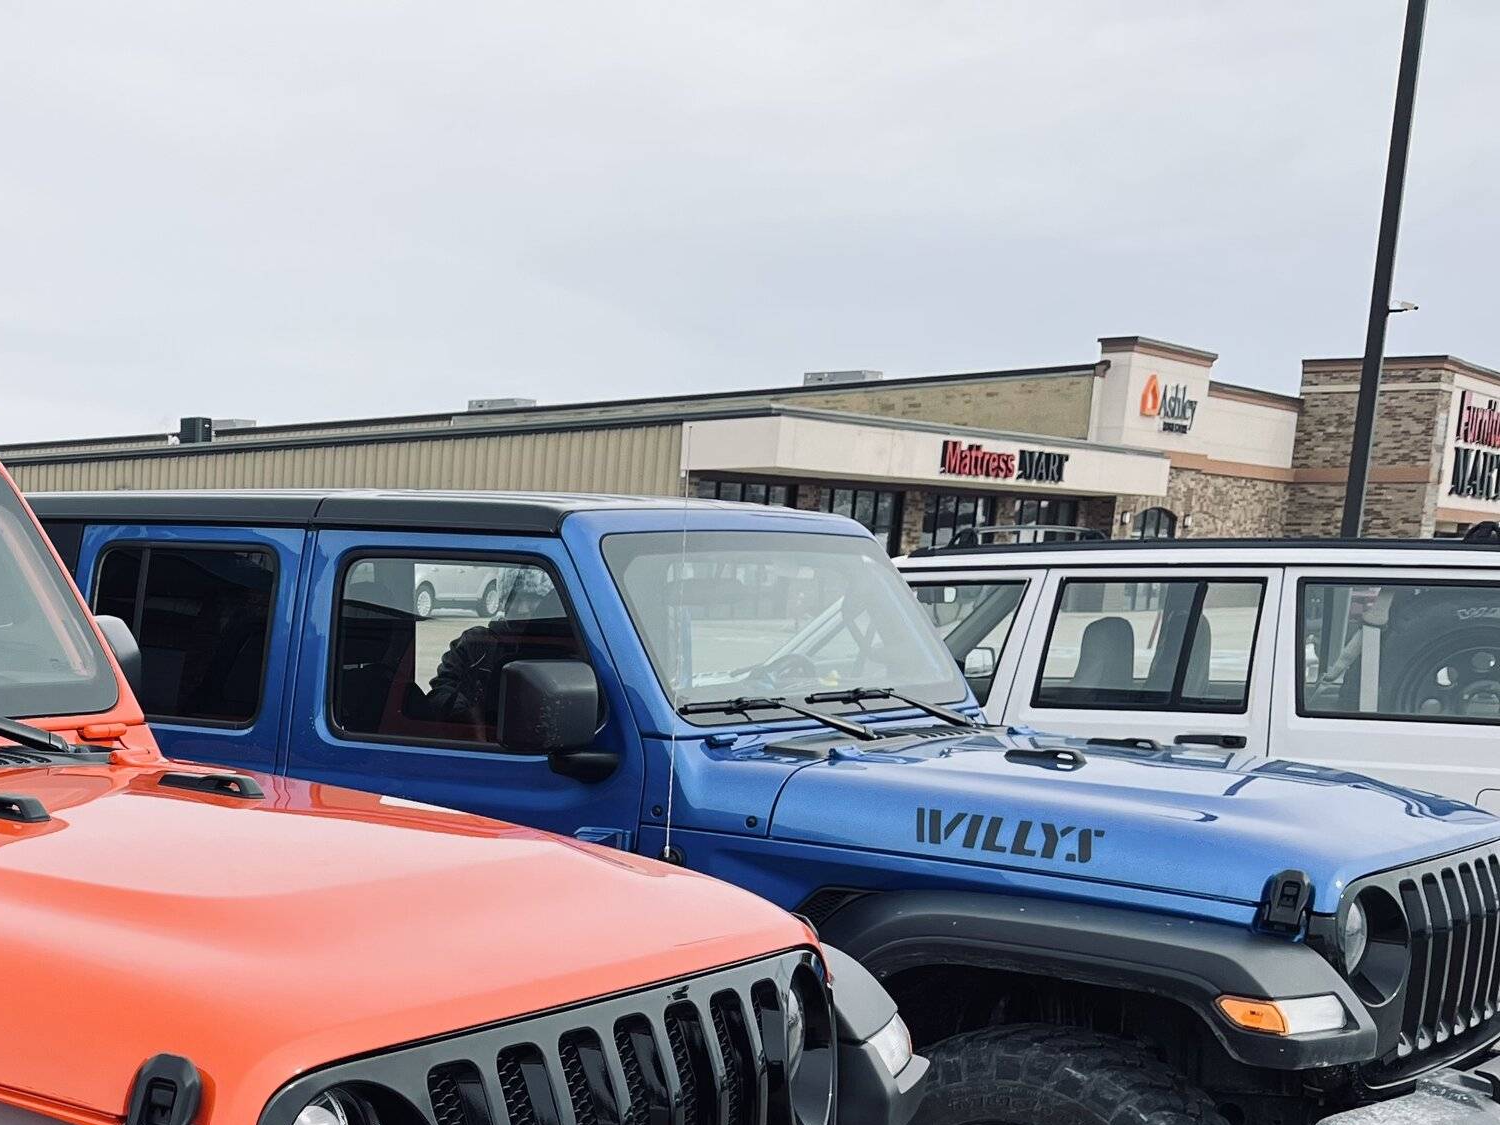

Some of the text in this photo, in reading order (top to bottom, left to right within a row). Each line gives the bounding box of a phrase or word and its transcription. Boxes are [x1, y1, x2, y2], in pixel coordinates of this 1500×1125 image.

[941, 440, 1070, 484] Mattress MART
[916, 807, 1106, 864] WILLYS
